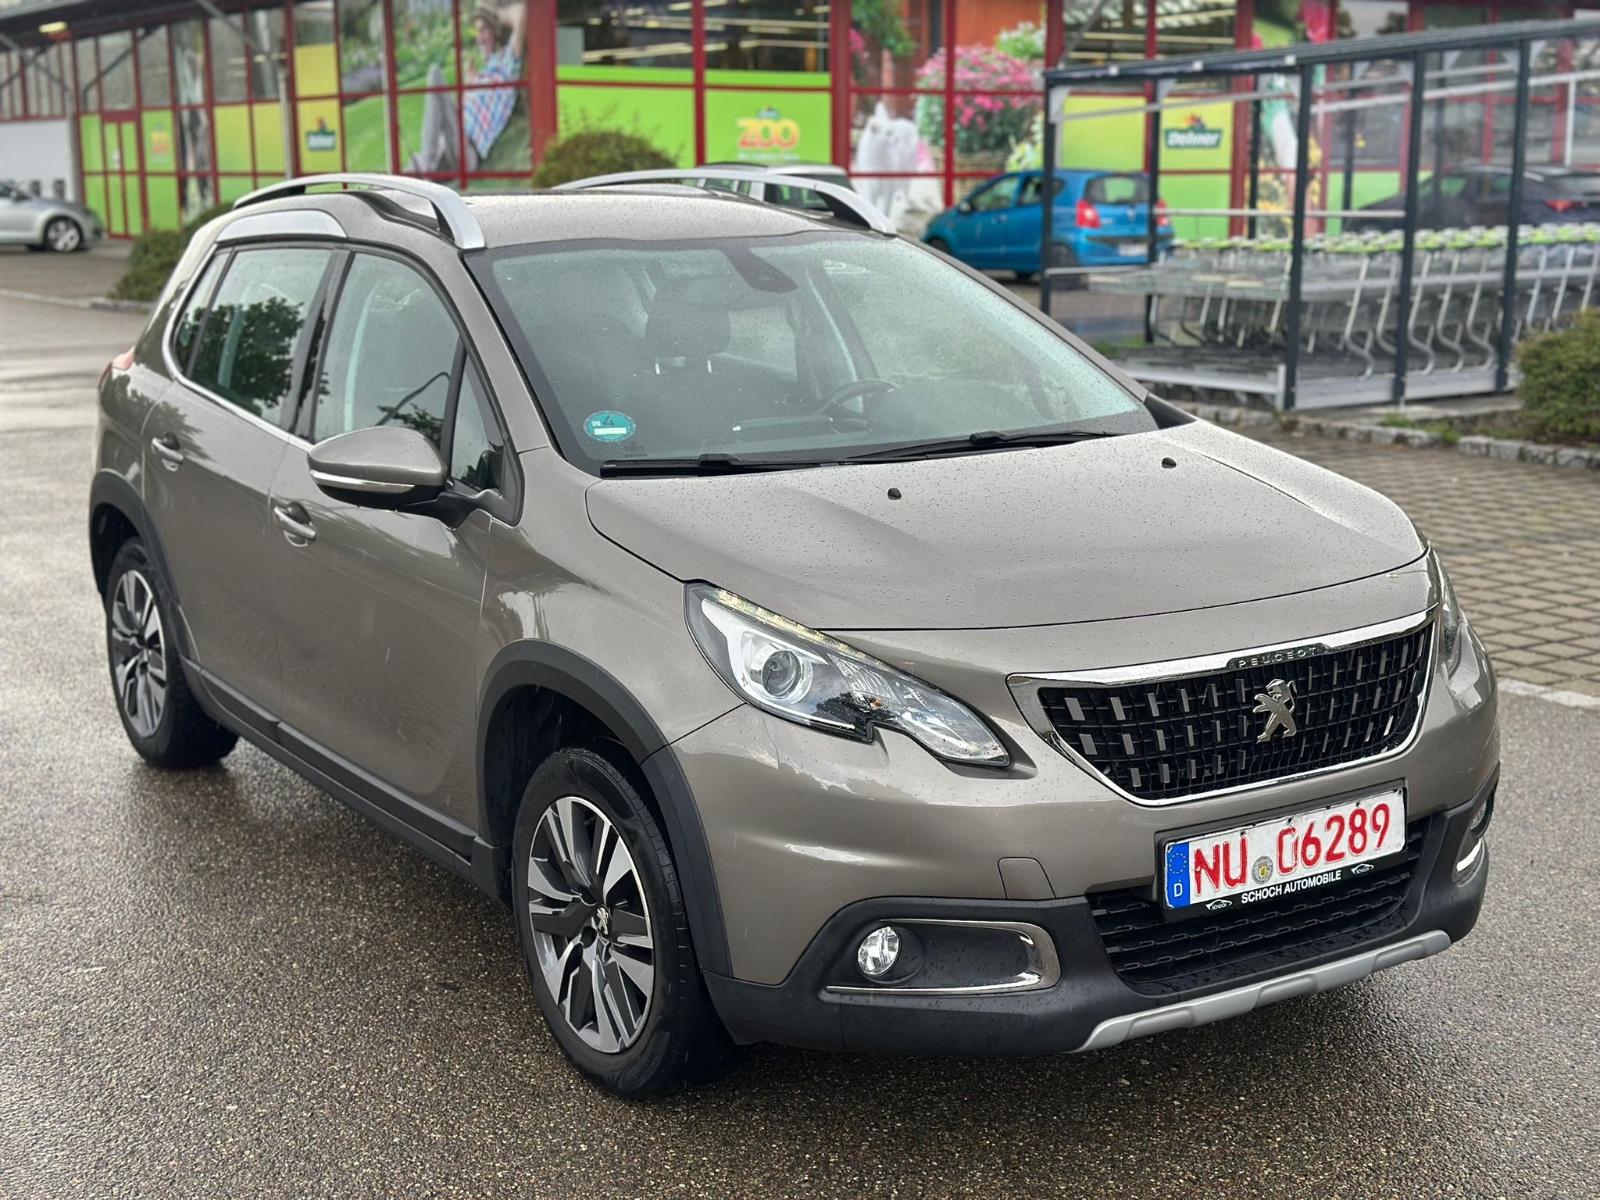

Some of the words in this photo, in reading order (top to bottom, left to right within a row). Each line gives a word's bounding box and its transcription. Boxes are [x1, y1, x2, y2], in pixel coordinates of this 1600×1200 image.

[737, 118, 800, 149] ZOO
[1238, 647, 1317, 668] PEUGEOT
[1193, 837, 1248, 895] NU
[1173, 882, 1183, 898] D
[1241, 883, 1283, 904] SCHOCH
[1284, 870, 1342, 894] AUTOMOBILE
